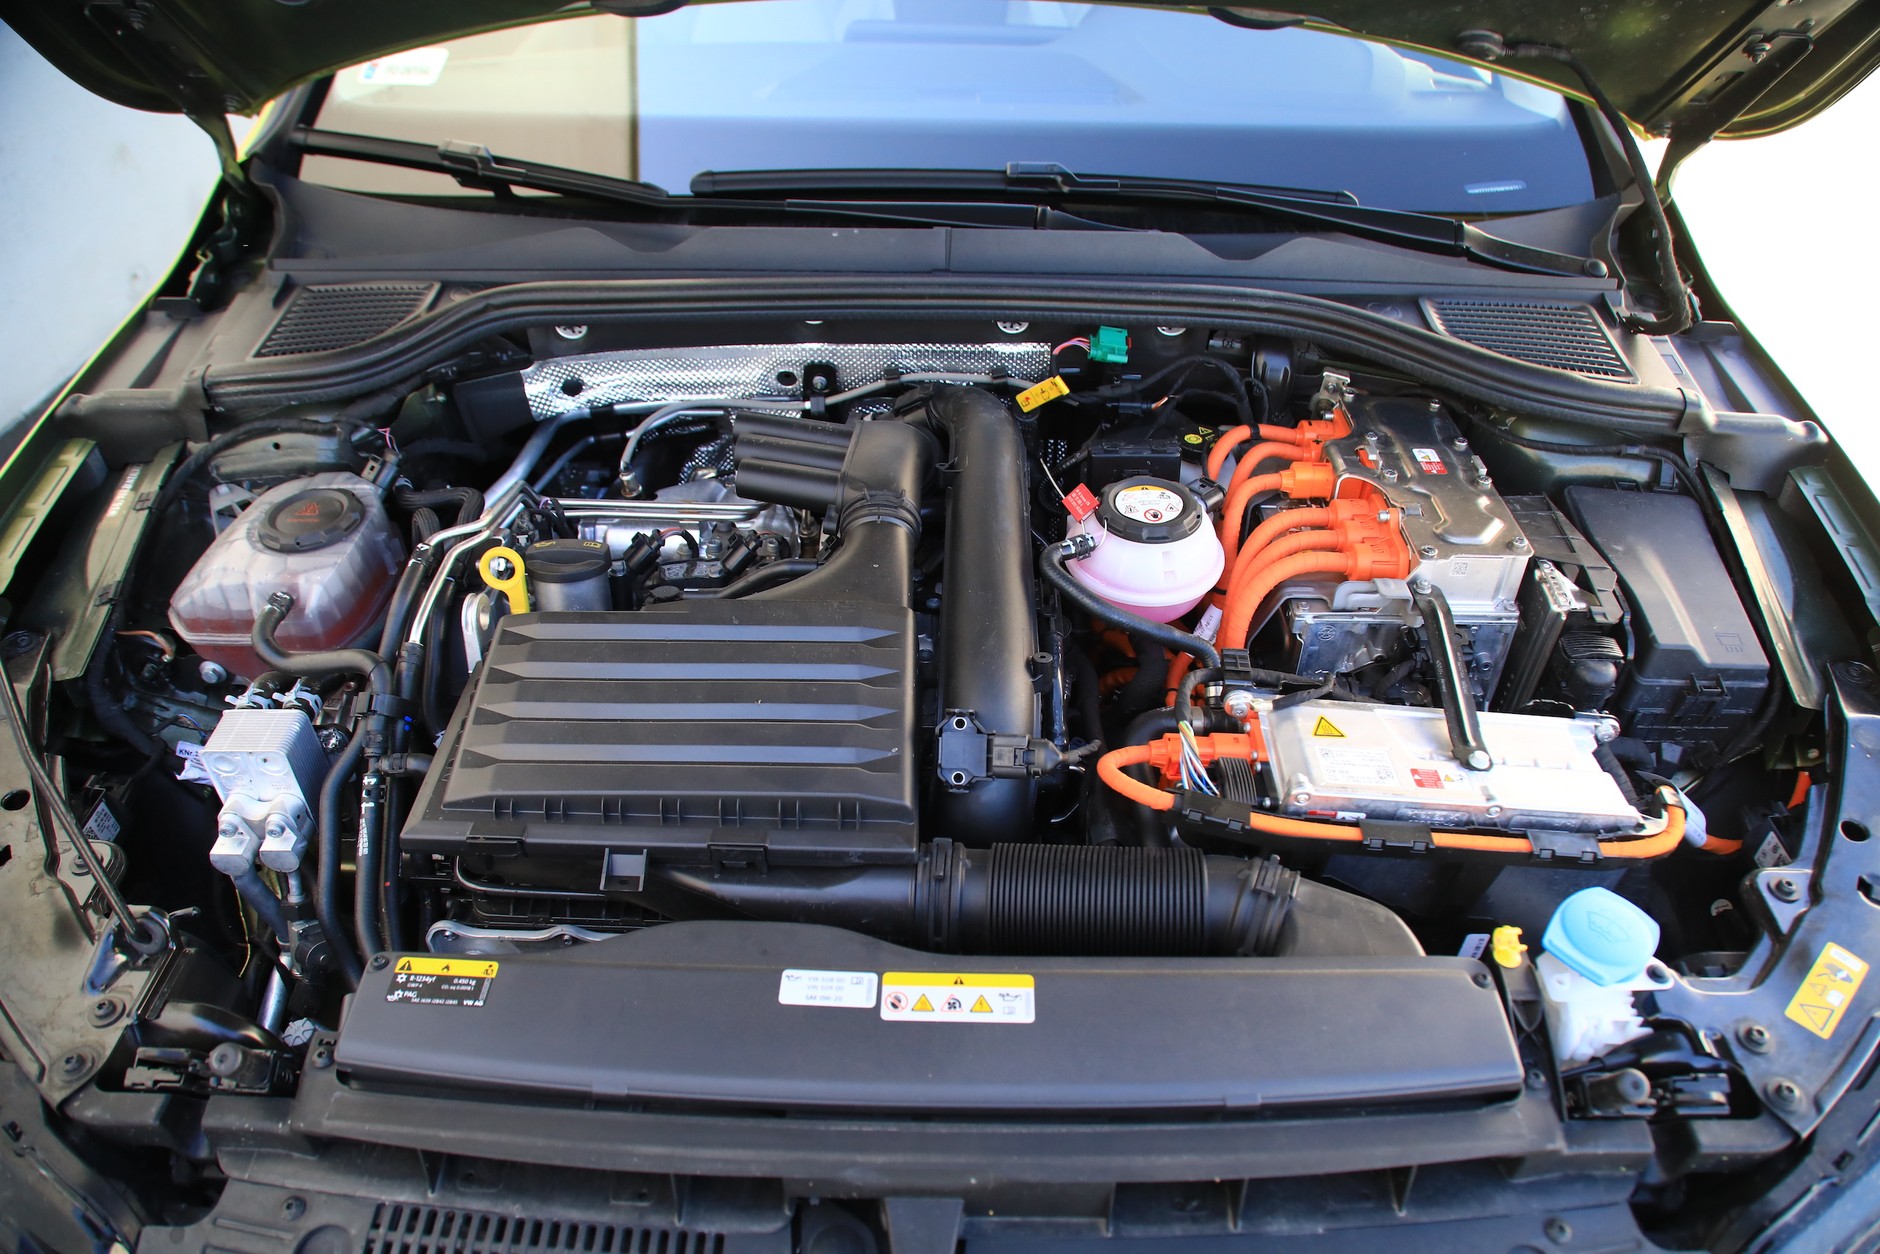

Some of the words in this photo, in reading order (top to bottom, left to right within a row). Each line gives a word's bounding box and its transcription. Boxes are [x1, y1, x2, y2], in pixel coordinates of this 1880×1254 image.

[410, 975, 437, 984] R-1234yf
[404, 990, 417, 998] PAG
[474, 999, 484, 1007] AG
